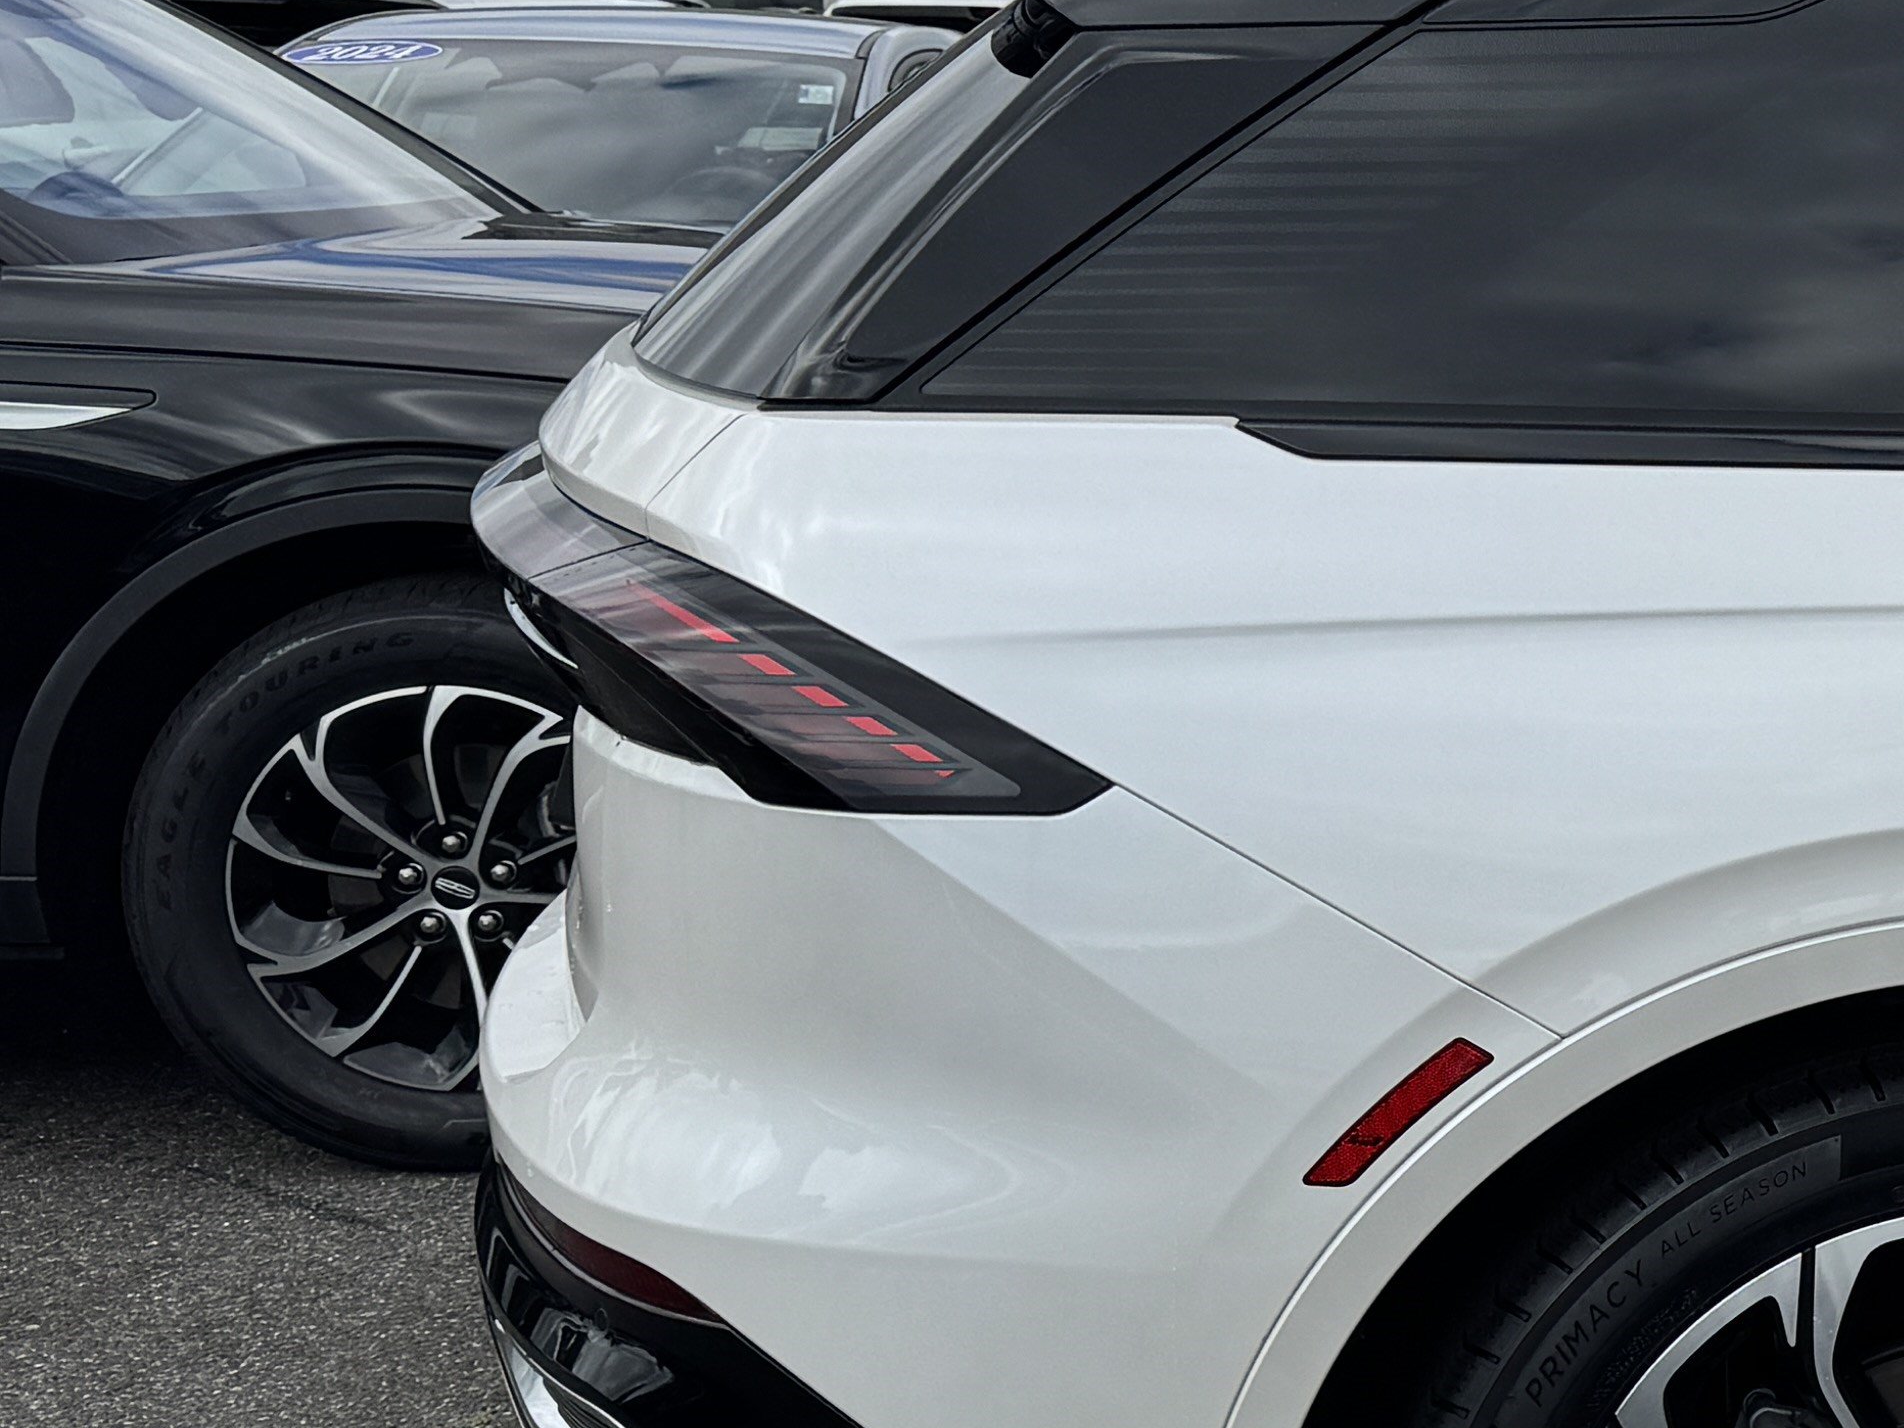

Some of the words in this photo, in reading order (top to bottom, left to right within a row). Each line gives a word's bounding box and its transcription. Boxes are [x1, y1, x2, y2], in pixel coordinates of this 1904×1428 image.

[303, 44, 421, 61] 2024
[156, 756, 207, 911] EAGLE
[215, 631, 415, 736] TOURING
[1524, 1259, 1647, 1409] PRIMACY
[1660, 1218, 1701, 1260] ALL
[1708, 1161, 1808, 1224] SEASON
